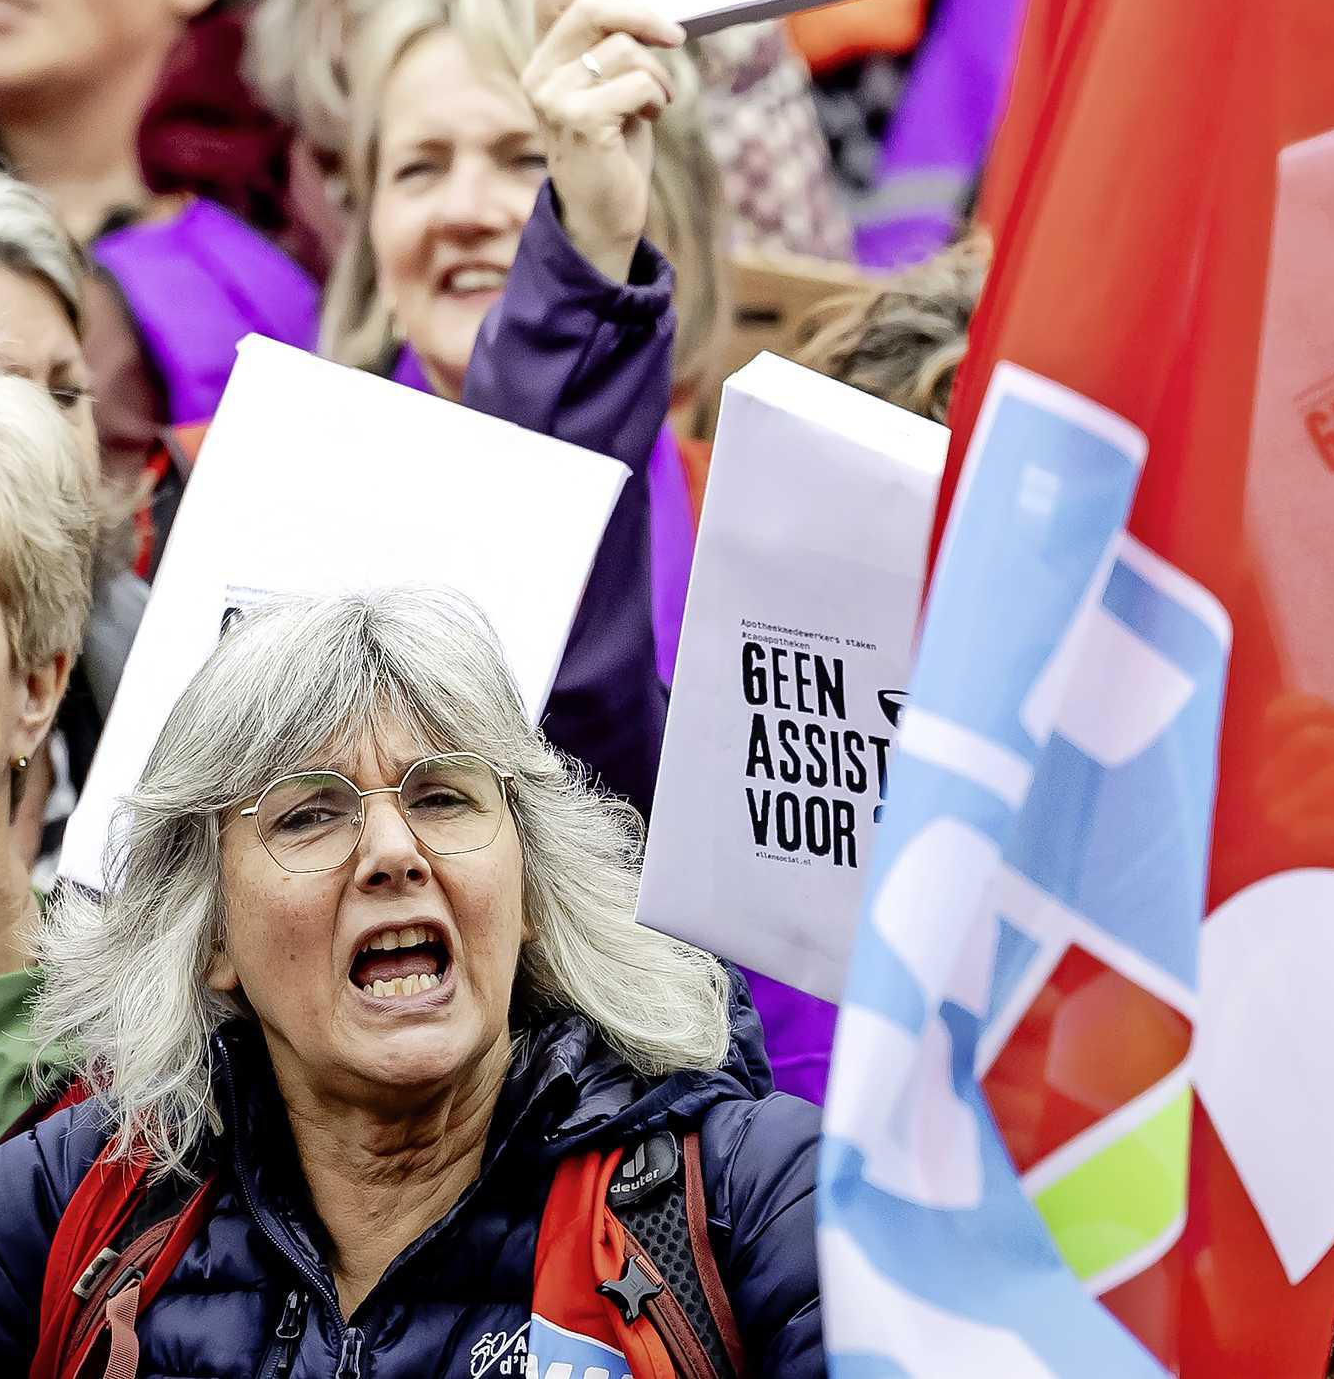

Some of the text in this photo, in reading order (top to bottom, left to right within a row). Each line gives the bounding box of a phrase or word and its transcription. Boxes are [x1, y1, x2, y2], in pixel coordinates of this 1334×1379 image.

[740, 618, 877, 651] Apotheekmedewerkers staken
[741, 630, 811, 650] #caoapotheken
[742, 641, 846, 720] GEEN
[746, 712, 890, 800] ASSIST
[746, 787, 857, 868] VOOR
[610, 1167, 660, 1194] deuter
